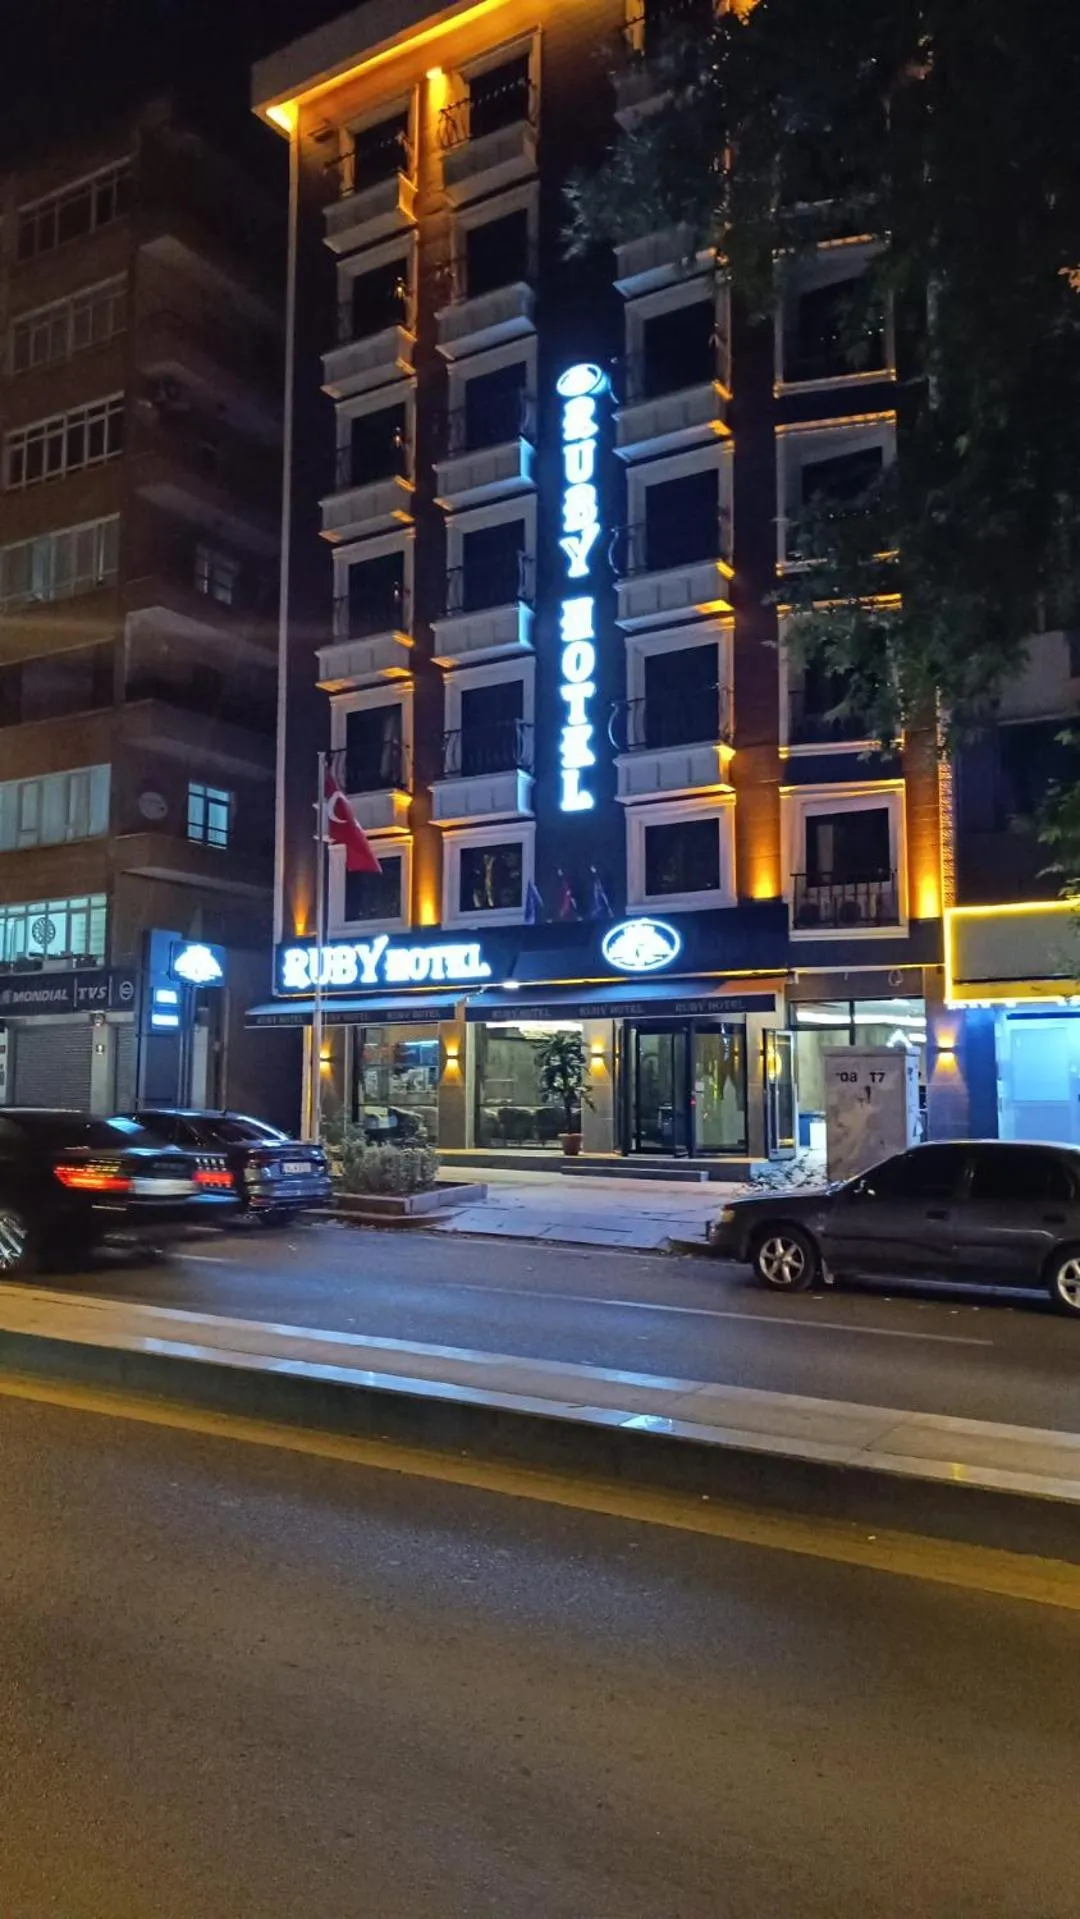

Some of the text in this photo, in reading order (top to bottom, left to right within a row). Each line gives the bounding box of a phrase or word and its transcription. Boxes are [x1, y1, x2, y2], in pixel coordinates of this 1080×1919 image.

[559, 395, 601, 812] RUBY HOTEL
[283, 934, 492, 989] RUBY HOTEL
[12, 988, 69, 1002] MONDIAL
[78, 986, 107, 1000] TVS
